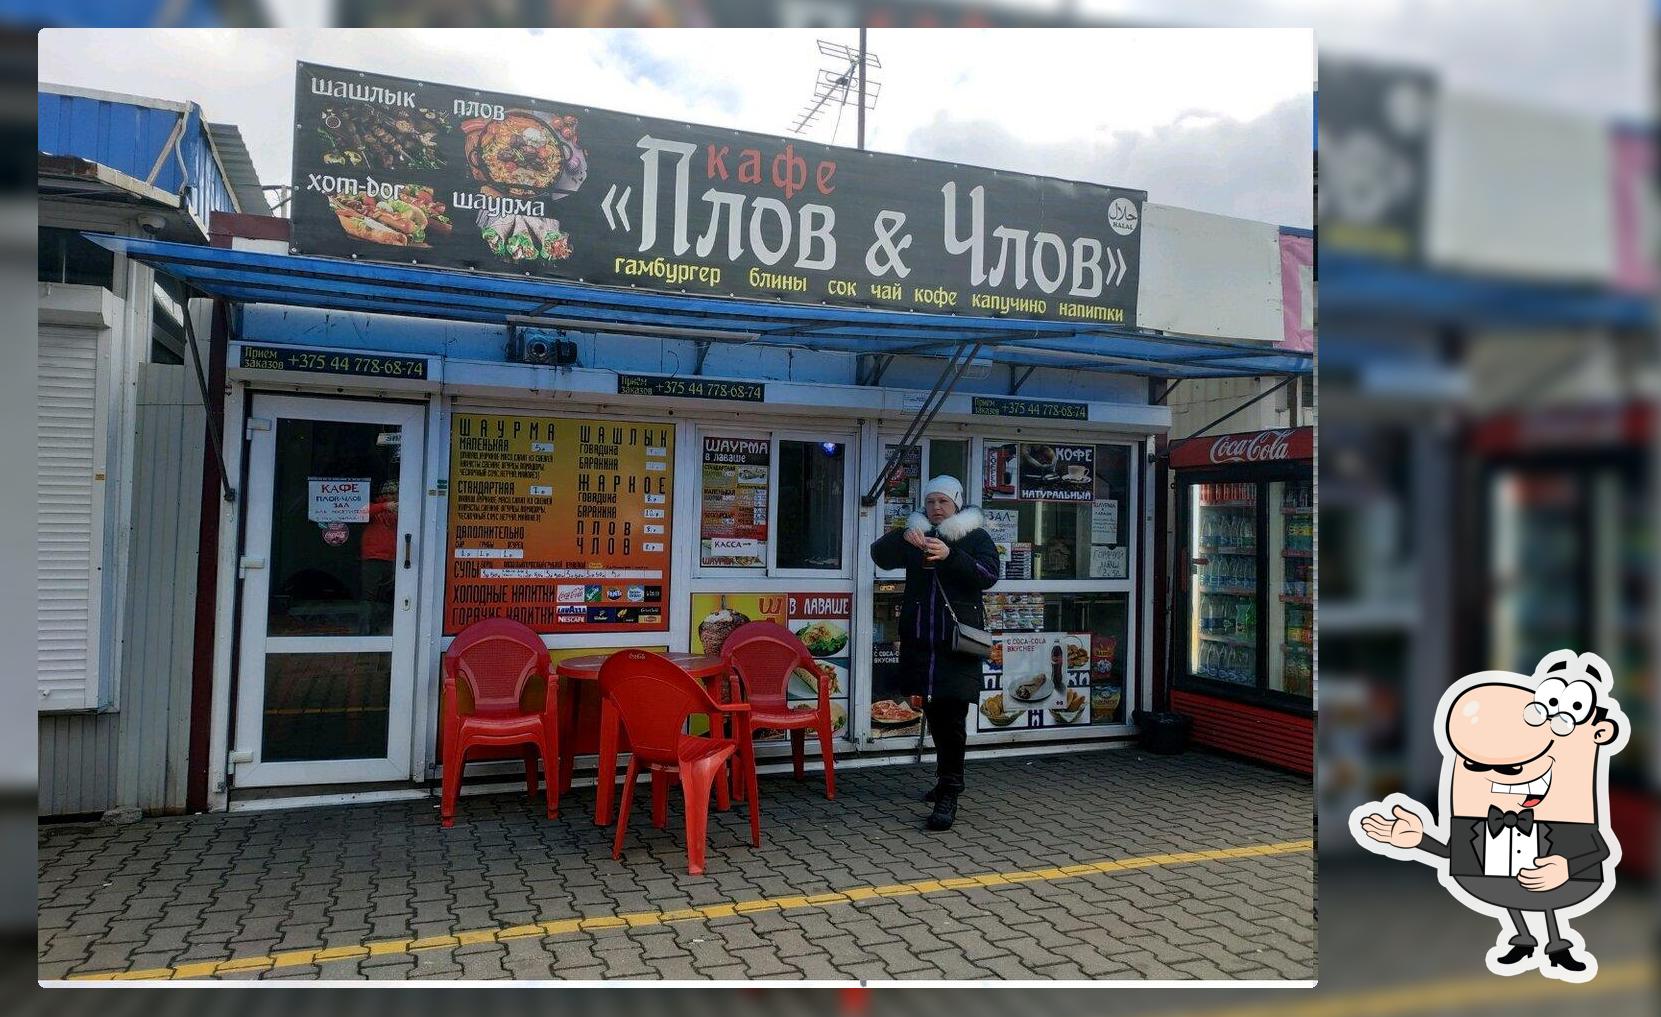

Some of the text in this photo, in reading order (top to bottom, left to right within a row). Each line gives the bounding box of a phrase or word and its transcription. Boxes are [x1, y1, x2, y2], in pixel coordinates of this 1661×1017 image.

[453, 99, 505, 121] плов
[706, 143, 837, 200] кафе
[601, 134, 1127, 298] «Плов & Члов»
[615, 255, 1124, 322] гамбургер блины сок чай кофе капучино напитки
[244, 358, 284, 370] заказов
[288, 354, 423, 376] +375 44 778-68-74
[655, 380, 761, 399] +375 44 778-68-74
[1002, 402, 1086, 418] +375 44 778-68-74
[460, 418, 555, 441] ШАУРМА
[580, 425, 667, 447] ШАШЛЫК
[459, 437, 509, 451] МАЛЕНЬКАЯ
[705, 440, 768, 454] ШАУРМА
[1210, 429, 1293, 464] Coca-Cola
[579, 456, 618, 471] БАРАНИНА
[1055, 447, 1092, 462] КОФЕ
[321, 484, 359, 493] КАФЕ
[458, 480, 515, 496] СТАНДАРТНАЯ
[578, 474, 666, 495] ЖАРКОЕ
[577, 505, 617, 518] БАРАНИНА
[577, 520, 631, 536] ПЛОВ
[576, 537, 631, 556] ЧЛОВ
[454, 560, 479, 579] СУПЫ
[453, 585, 555, 605] ХОЛОДНЫЕ НАПИТКИ
[789, 597, 849, 615] В ЛАВАШЕ
